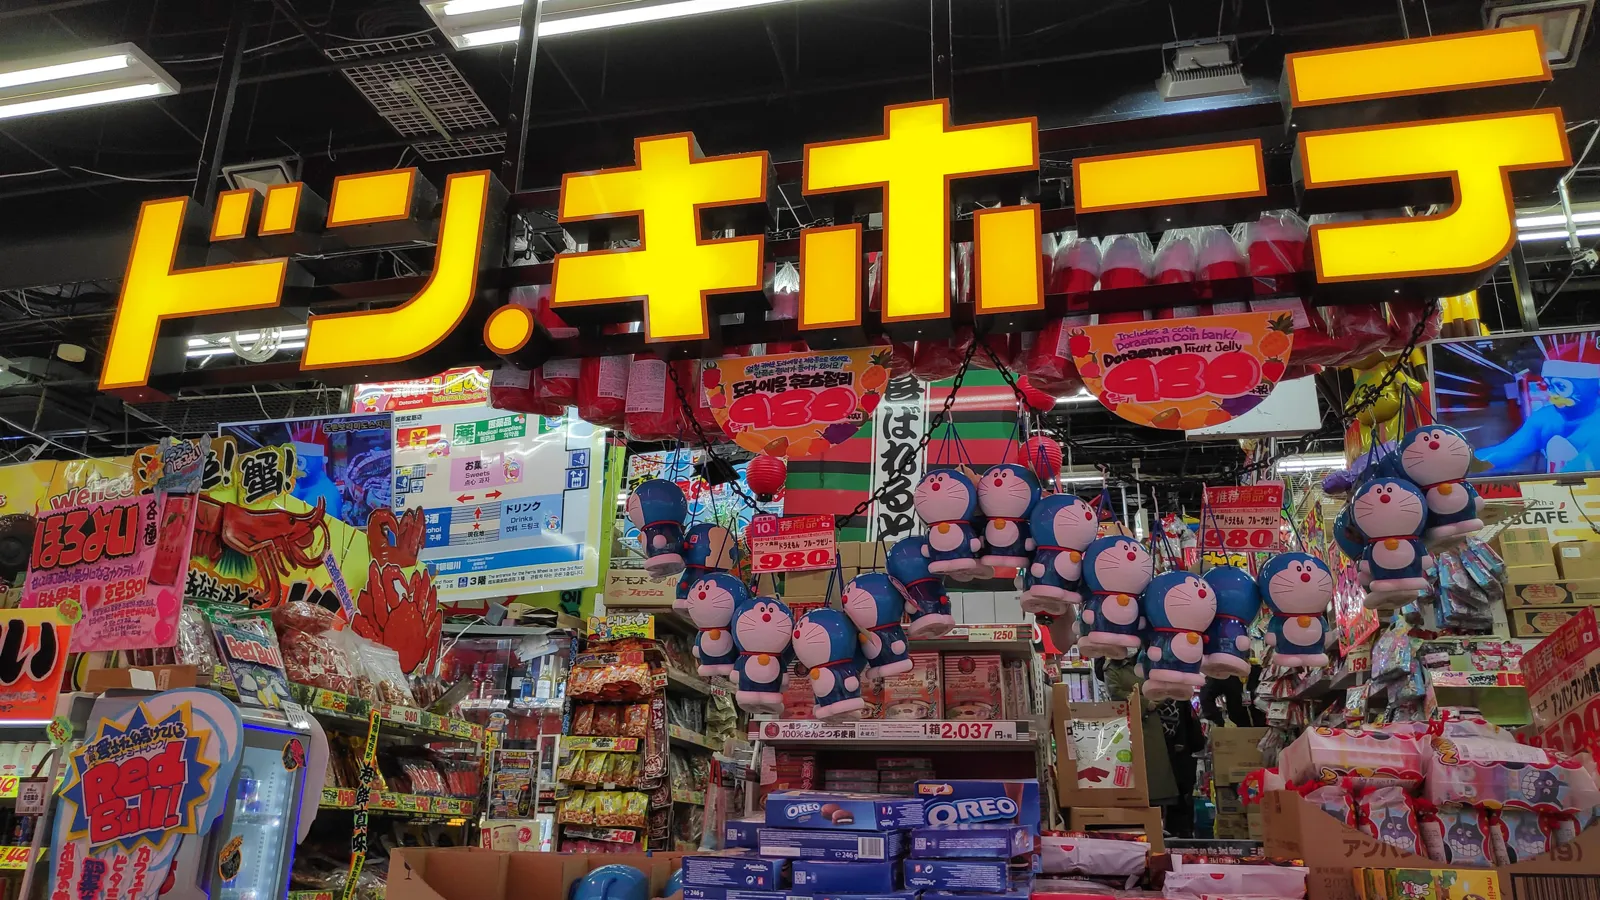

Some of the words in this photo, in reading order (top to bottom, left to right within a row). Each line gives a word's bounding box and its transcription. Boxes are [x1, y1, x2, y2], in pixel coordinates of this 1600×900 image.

[1115, 335, 1171, 351] Doraemon
[1202, 329, 1238, 342] bank!
[1116, 327, 1165, 341] Includes
[1171, 325, 1196, 334] cute
[1103, 345, 1182, 368] Doraemon
[1184, 342, 1212, 354] Fruit
[1214, 341, 1242, 353] Jelly
[1103, 351, 1262, 402] 980
[728, 387, 858, 431] 980
[465, 472, 491, 480] Sweets
[505, 501, 541, 515] ドリンク
[510, 515, 533, 523] Drinks
[30, 505, 139, 571] ほろよい
[1205, 529, 1274, 548] 980
[759, 549, 830, 569] 980
[611, 576, 648, 585] アーモンド
[992, 631, 1013, 641] 1250
[1352, 657, 1368, 671] 158
[404, 710, 418, 722] 980
[941, 723, 993, 740] 2,037
[83, 741, 187, 819] Red
[89, 783, 182, 845] Bull!
[786, 803, 821, 818] OREO
[927, 799, 1016, 826] OREO
[1207, 847, 1217, 855] the
[1218, 846, 1228, 855] 3rd
[1229, 846, 1243, 855] floor
[1486, 876, 1495, 900] meiji
